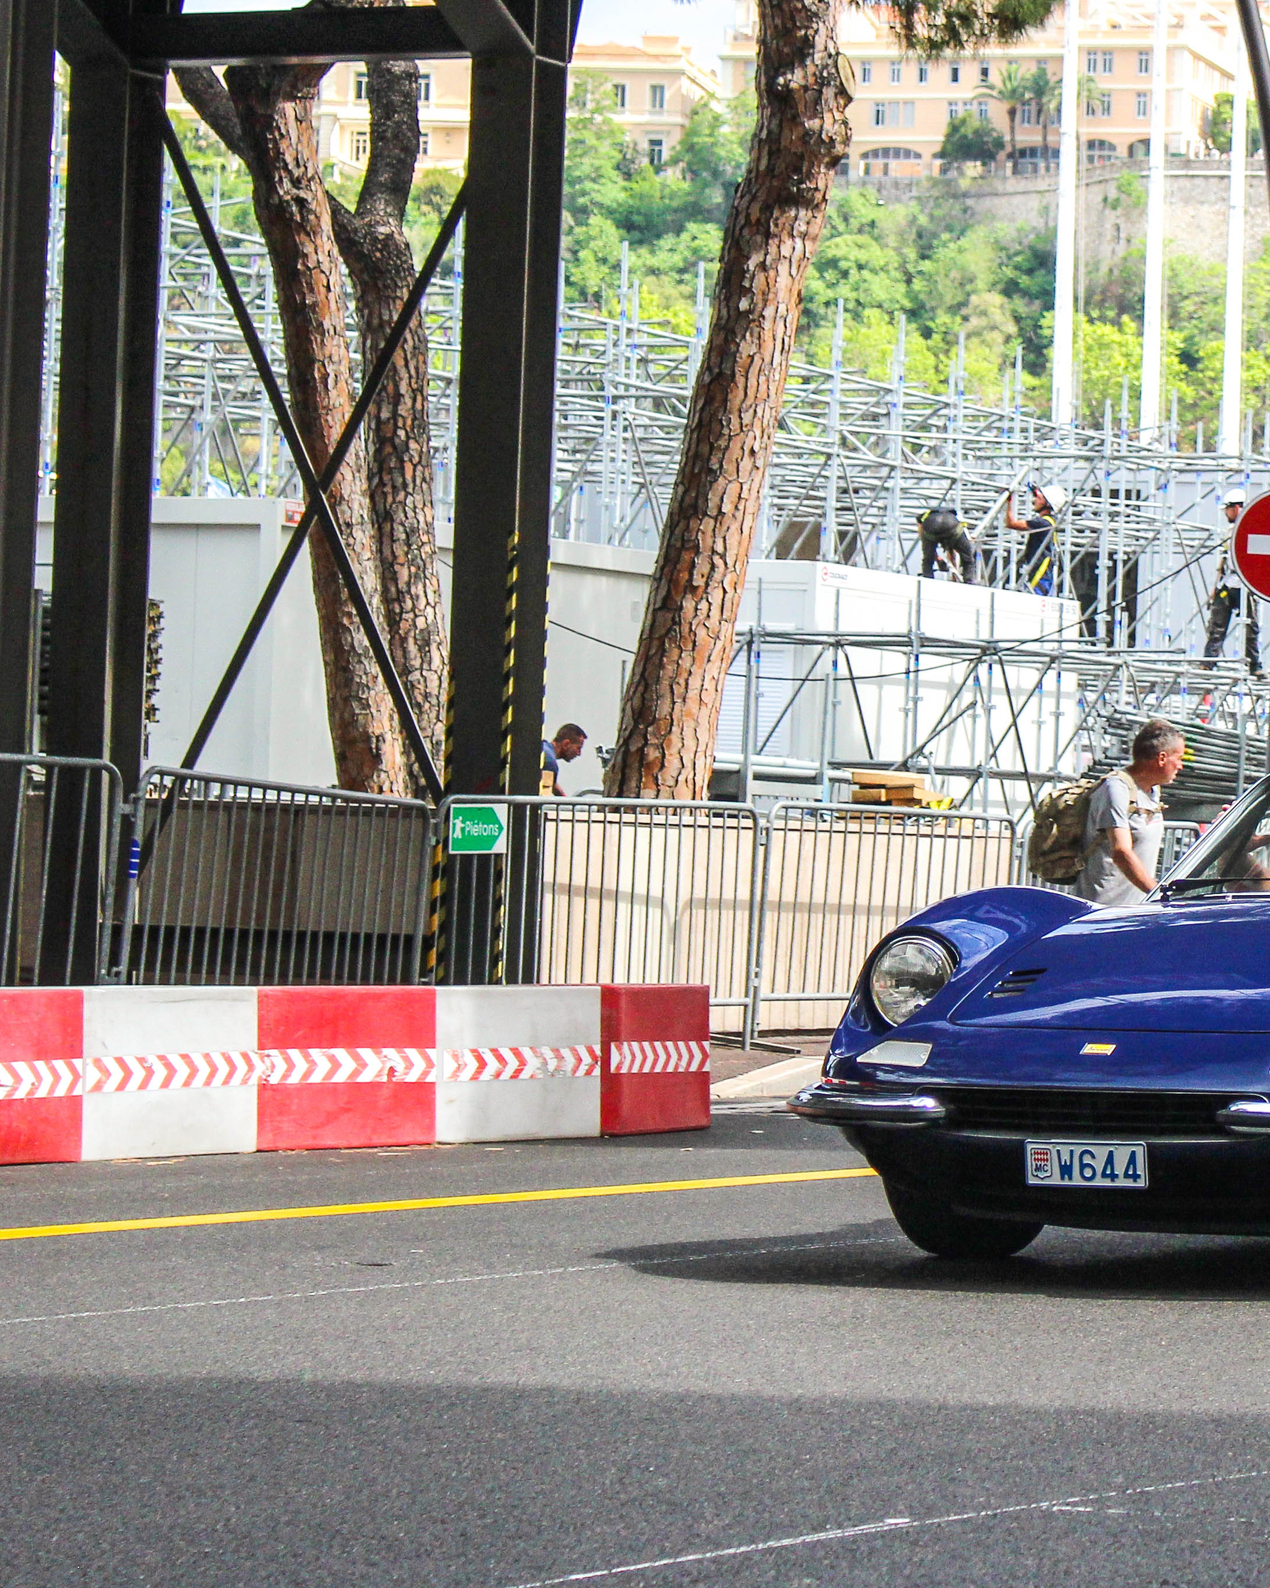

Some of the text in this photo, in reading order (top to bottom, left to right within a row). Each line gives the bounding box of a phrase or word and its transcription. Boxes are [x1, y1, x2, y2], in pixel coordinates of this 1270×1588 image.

[465, 820, 499, 836] Piétons
[1034, 1163, 1049, 1173] MC
[1056, 1148, 1142, 1182] W644
